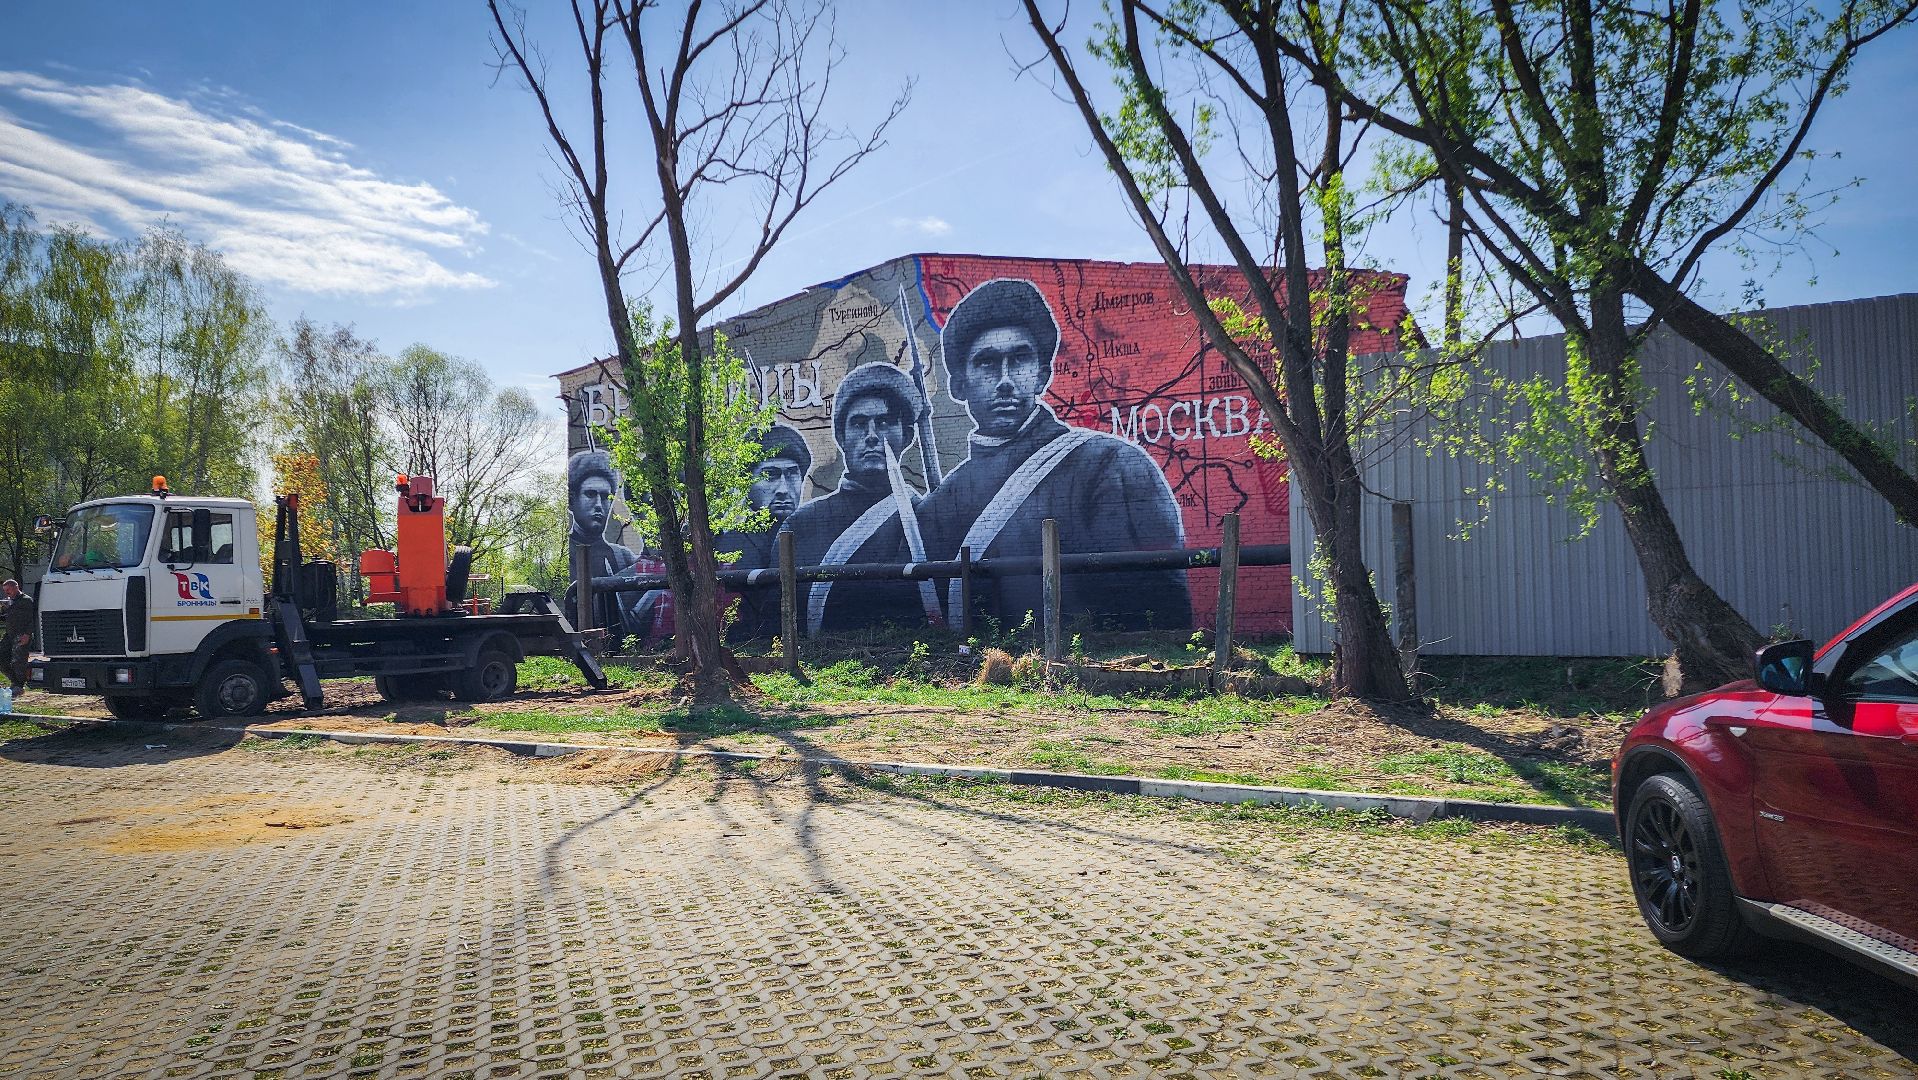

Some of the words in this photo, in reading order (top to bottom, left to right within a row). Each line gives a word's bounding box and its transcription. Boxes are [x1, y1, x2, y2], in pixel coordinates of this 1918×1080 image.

[1090, 291, 1154, 314] Дмитров
[1103, 340, 1140, 358] Икша
[180, 581, 209, 592] ТВК
